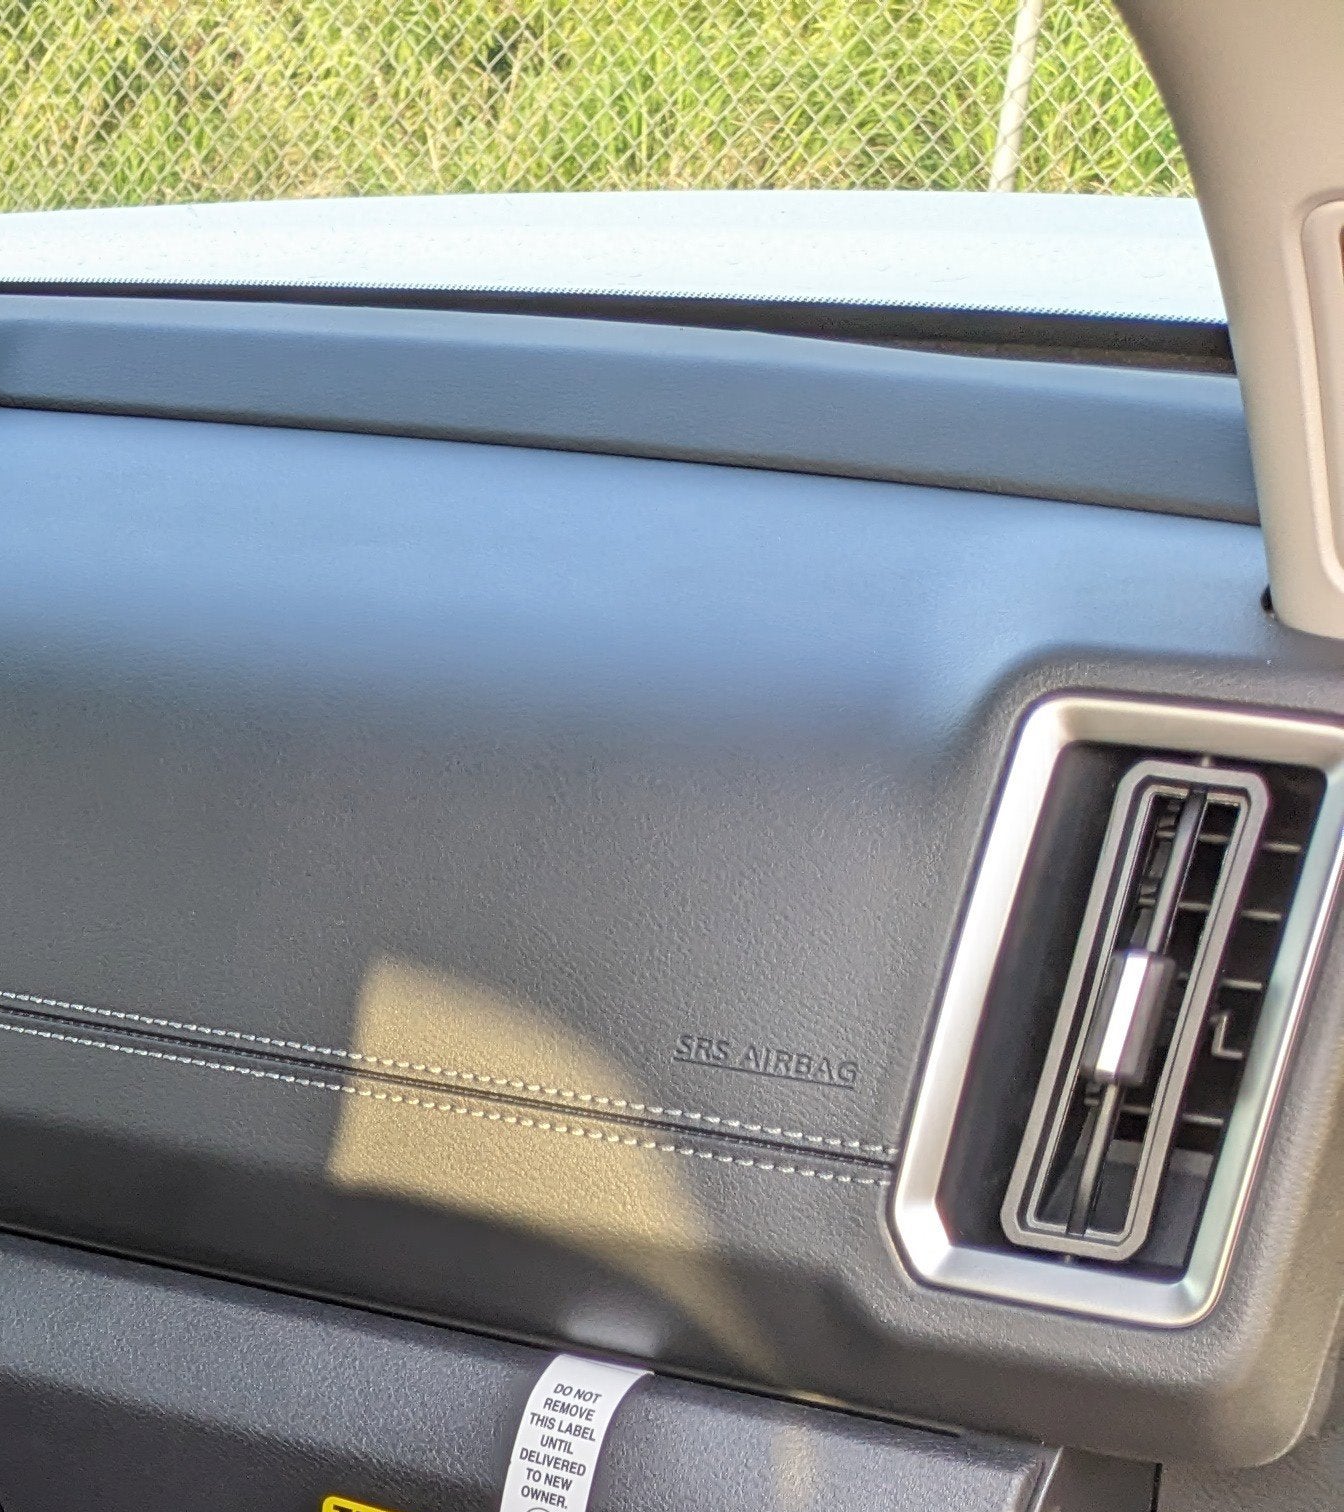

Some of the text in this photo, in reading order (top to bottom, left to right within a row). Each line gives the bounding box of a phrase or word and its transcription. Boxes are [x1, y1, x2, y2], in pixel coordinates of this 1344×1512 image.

[675, 1034, 861, 1085] SRS AIRBAG
[553, 1383, 602, 1404] DO NOT
[543, 1398, 596, 1421] REMOVE
[530, 1412, 596, 1442] THIS LABEL
[540, 1434, 574, 1455] UNTIL
[519, 1447, 586, 1477] DELIVERED
[526, 1468, 573, 1492] TO NEW
[521, 1485, 568, 1509] OWNER.
